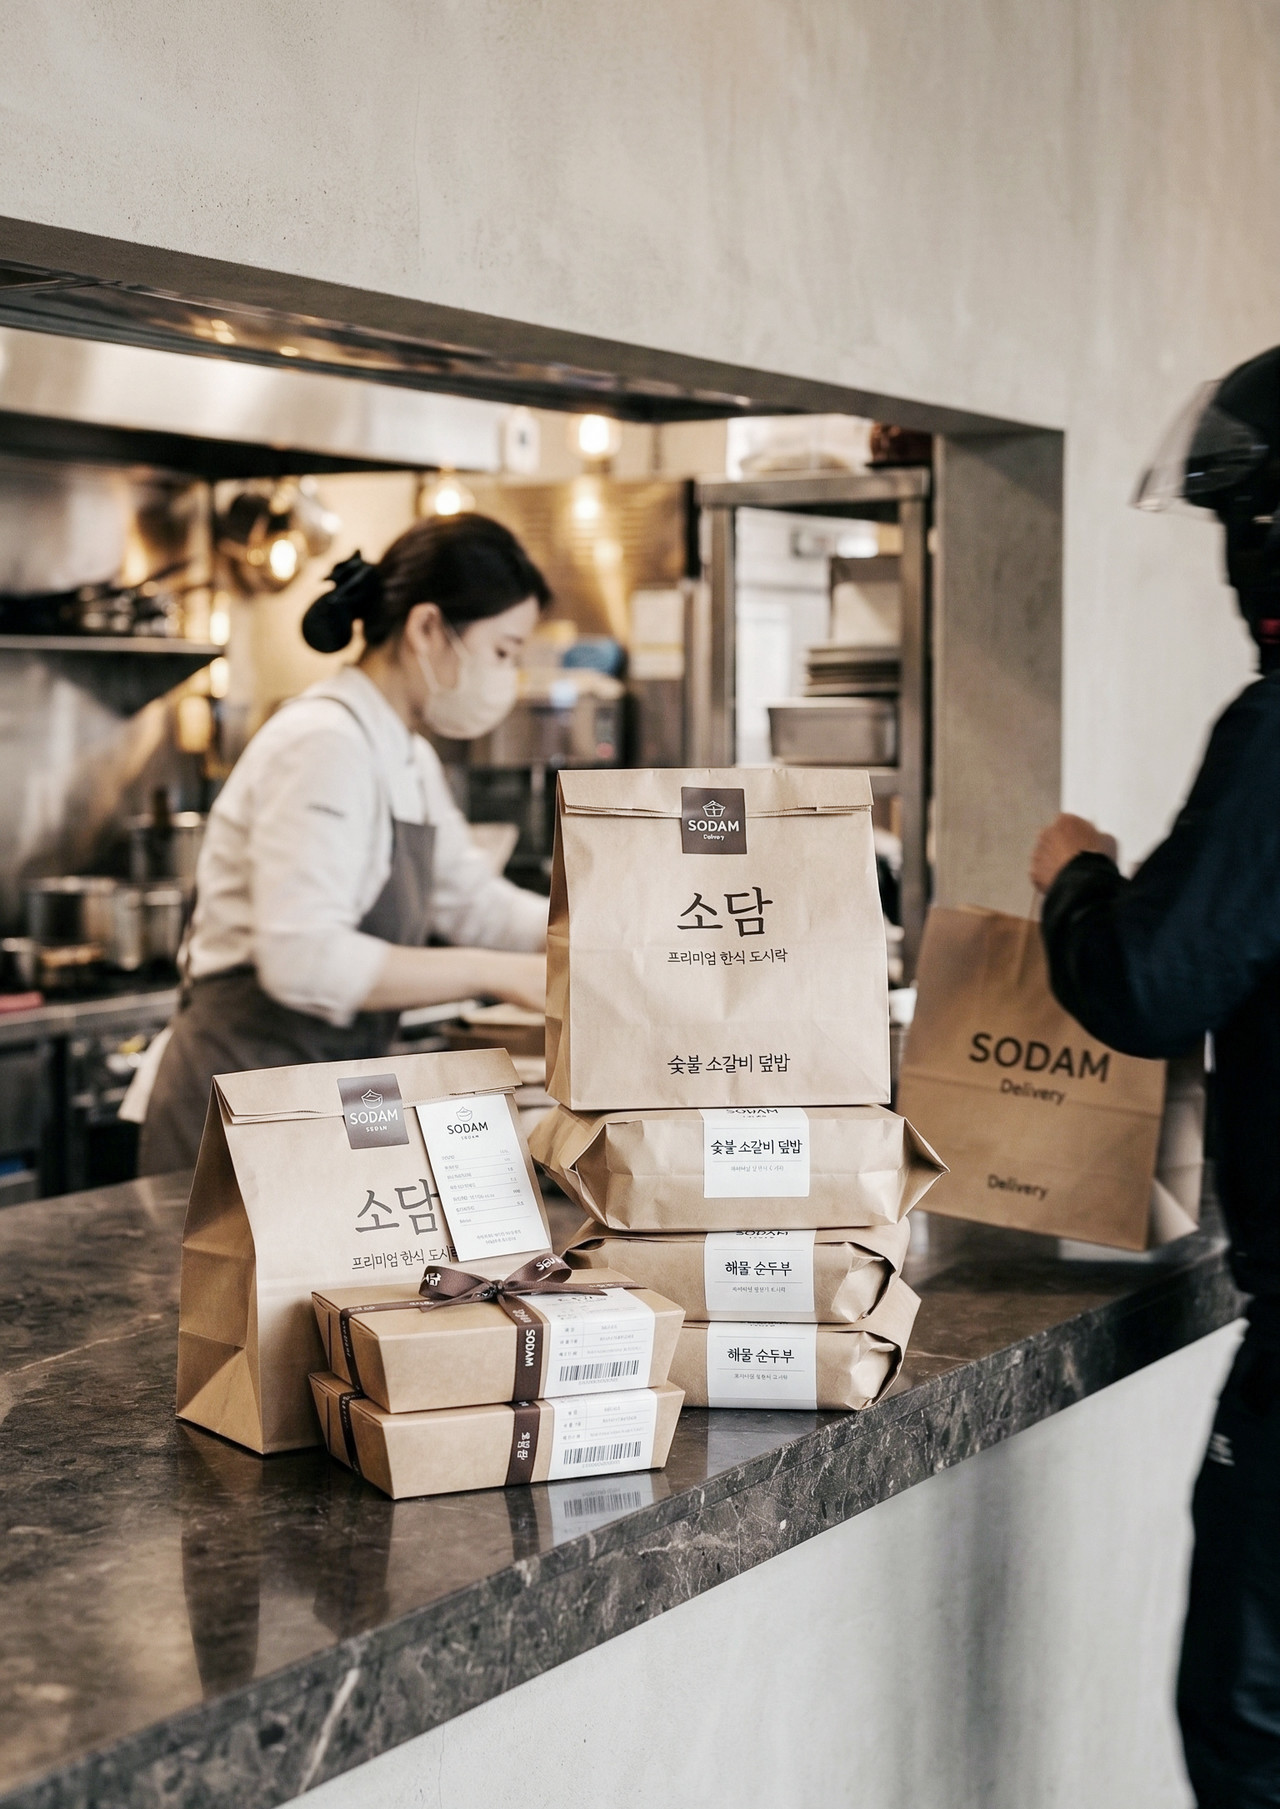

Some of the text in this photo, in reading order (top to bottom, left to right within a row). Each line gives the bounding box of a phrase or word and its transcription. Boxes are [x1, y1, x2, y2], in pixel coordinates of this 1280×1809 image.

[688, 820, 740, 832] SODAM
[677, 886, 773, 937] 소담
[667, 948, 788, 966] 프리미엄 한식 도시락
[667, 1052, 790, 1075] 숯불 소갈비 덮밥
[969, 1031, 1111, 1084] SODAM
[1000, 1078, 1067, 1105] Delivery
[350, 1108, 398, 1125] SODAM
[446, 1121, 489, 1136] SODAM
[711, 1139, 803, 1155] 숯불 소갈비 덮밥
[987, 1174, 1049, 1201] Delivery
[355, 1178, 439, 1235] 소담
[351, 1252, 399, 1271] 프리미엄
[400, 1248, 425, 1267] 한식
[725, 1260, 792, 1276] 해물 순두부
[524, 1329, 536, 1367] SODAM
[727, 1347, 795, 1364] 해물 순두부
